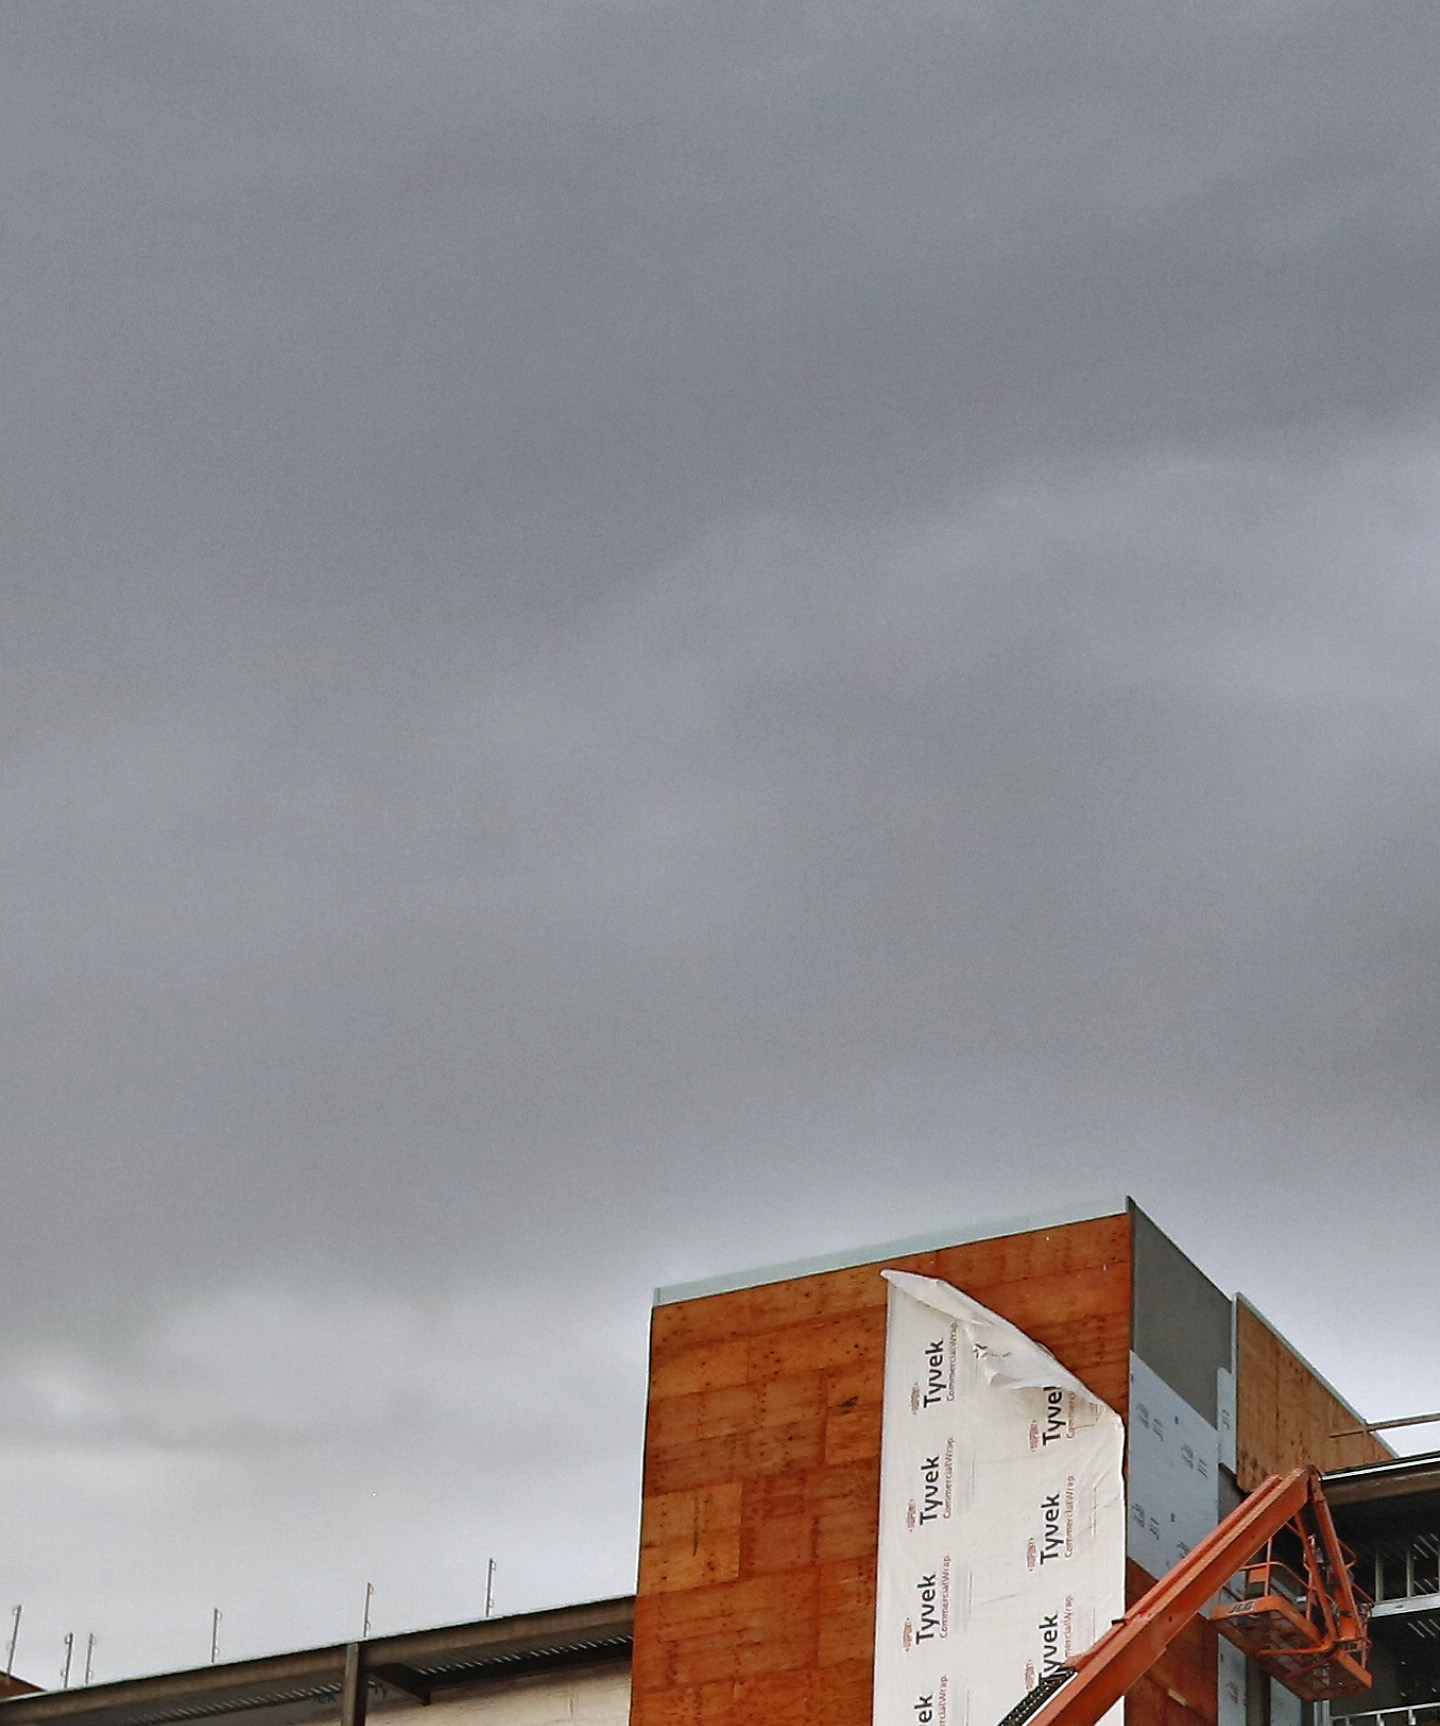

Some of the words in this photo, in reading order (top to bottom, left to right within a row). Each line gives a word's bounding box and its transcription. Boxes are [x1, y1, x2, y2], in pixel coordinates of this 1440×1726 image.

[923, 1341, 947, 1408] Tyvek
[920, 1457, 942, 1525] Tyvek
[943, 1438, 954, 1519] CommercialWrap
[1040, 1495, 1063, 1564] Tyvek
[1065, 1476, 1074, 1558] CommercialWrap
[916, 1574, 940, 1644] Tyvek
[940, 1555, 951, 1639] CommercialWrap
